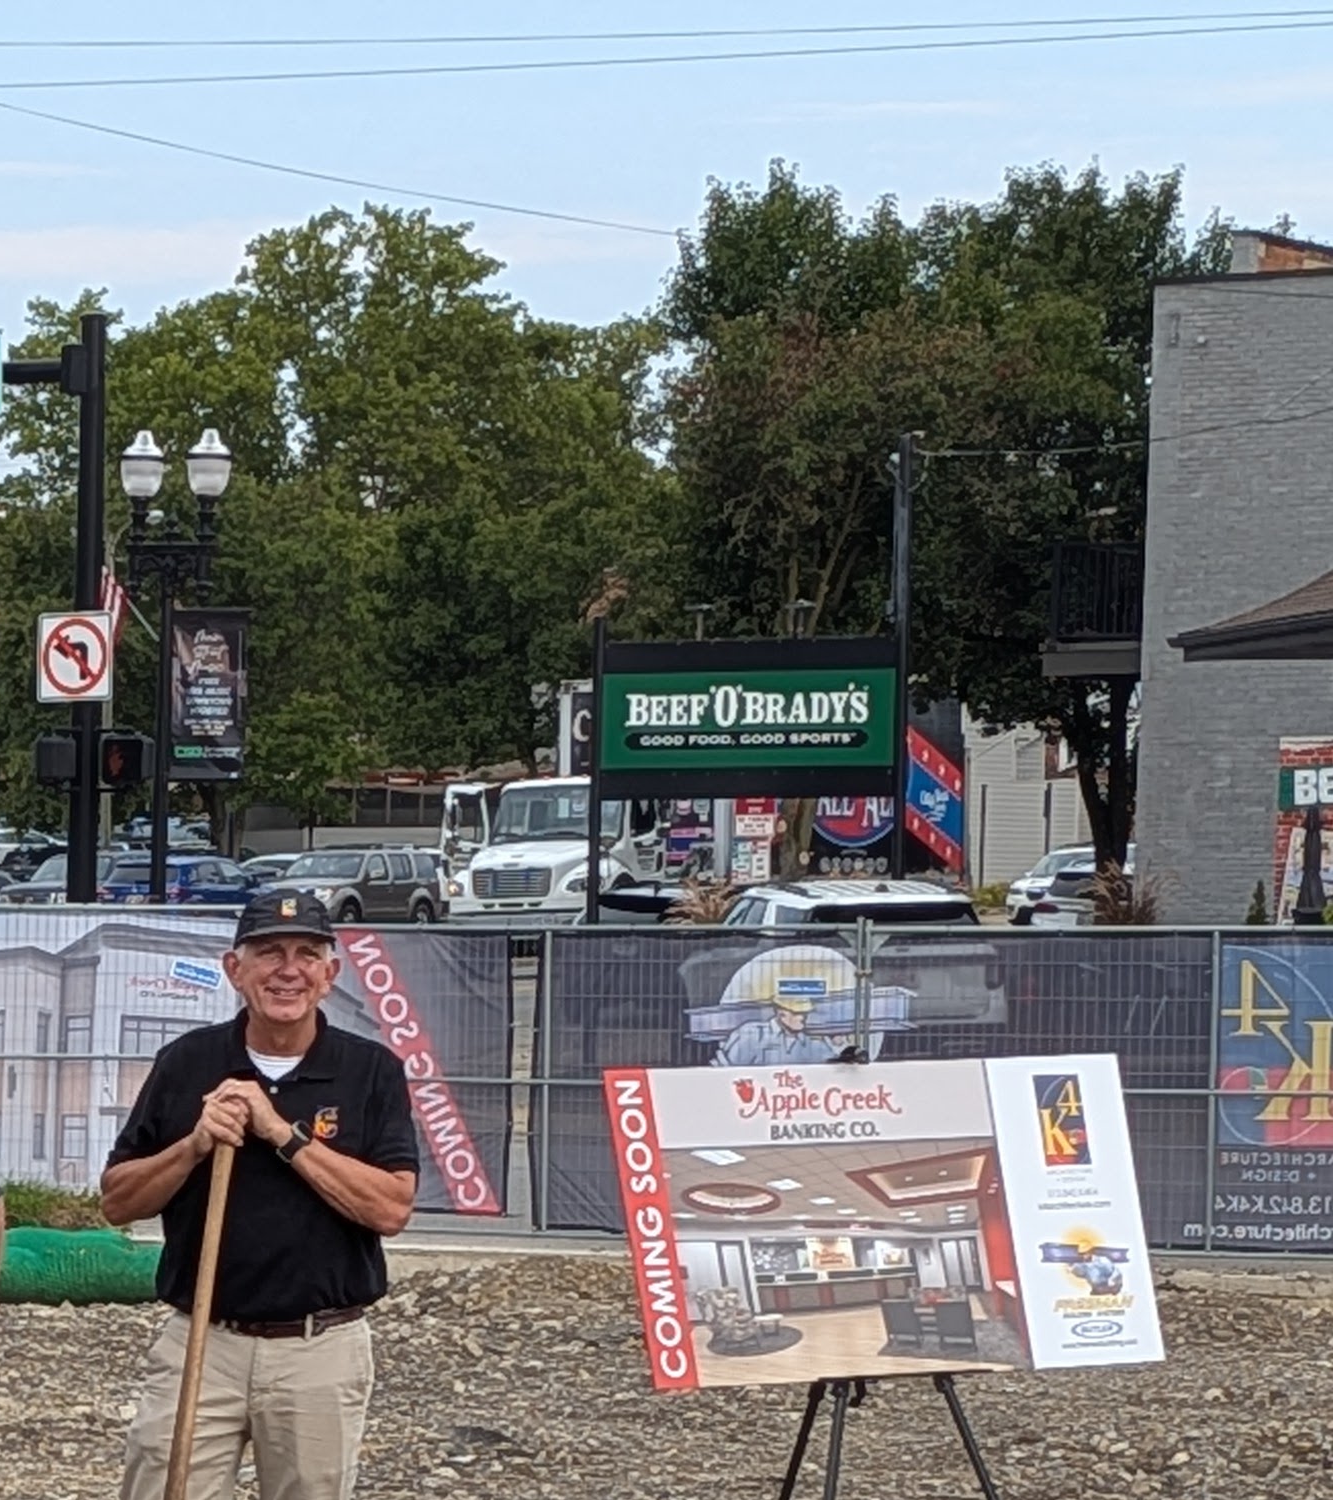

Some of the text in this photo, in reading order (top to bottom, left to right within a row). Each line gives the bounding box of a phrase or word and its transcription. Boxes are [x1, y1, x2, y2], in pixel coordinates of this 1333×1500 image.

[624, 693, 708, 727] BEEF
[741, 683, 869, 724] BRADY'S
[640, 735, 684, 746] GOOD
[689, 734, 735, 746] FOOD,
[741, 733, 785, 745] GOOD
[774, 1069, 804, 1089] The
[739, 1084, 903, 1120] Apple Creek
[770, 1120, 880, 1141] BANKING CO.
[614, 1079, 689, 1378] COMING SOON
